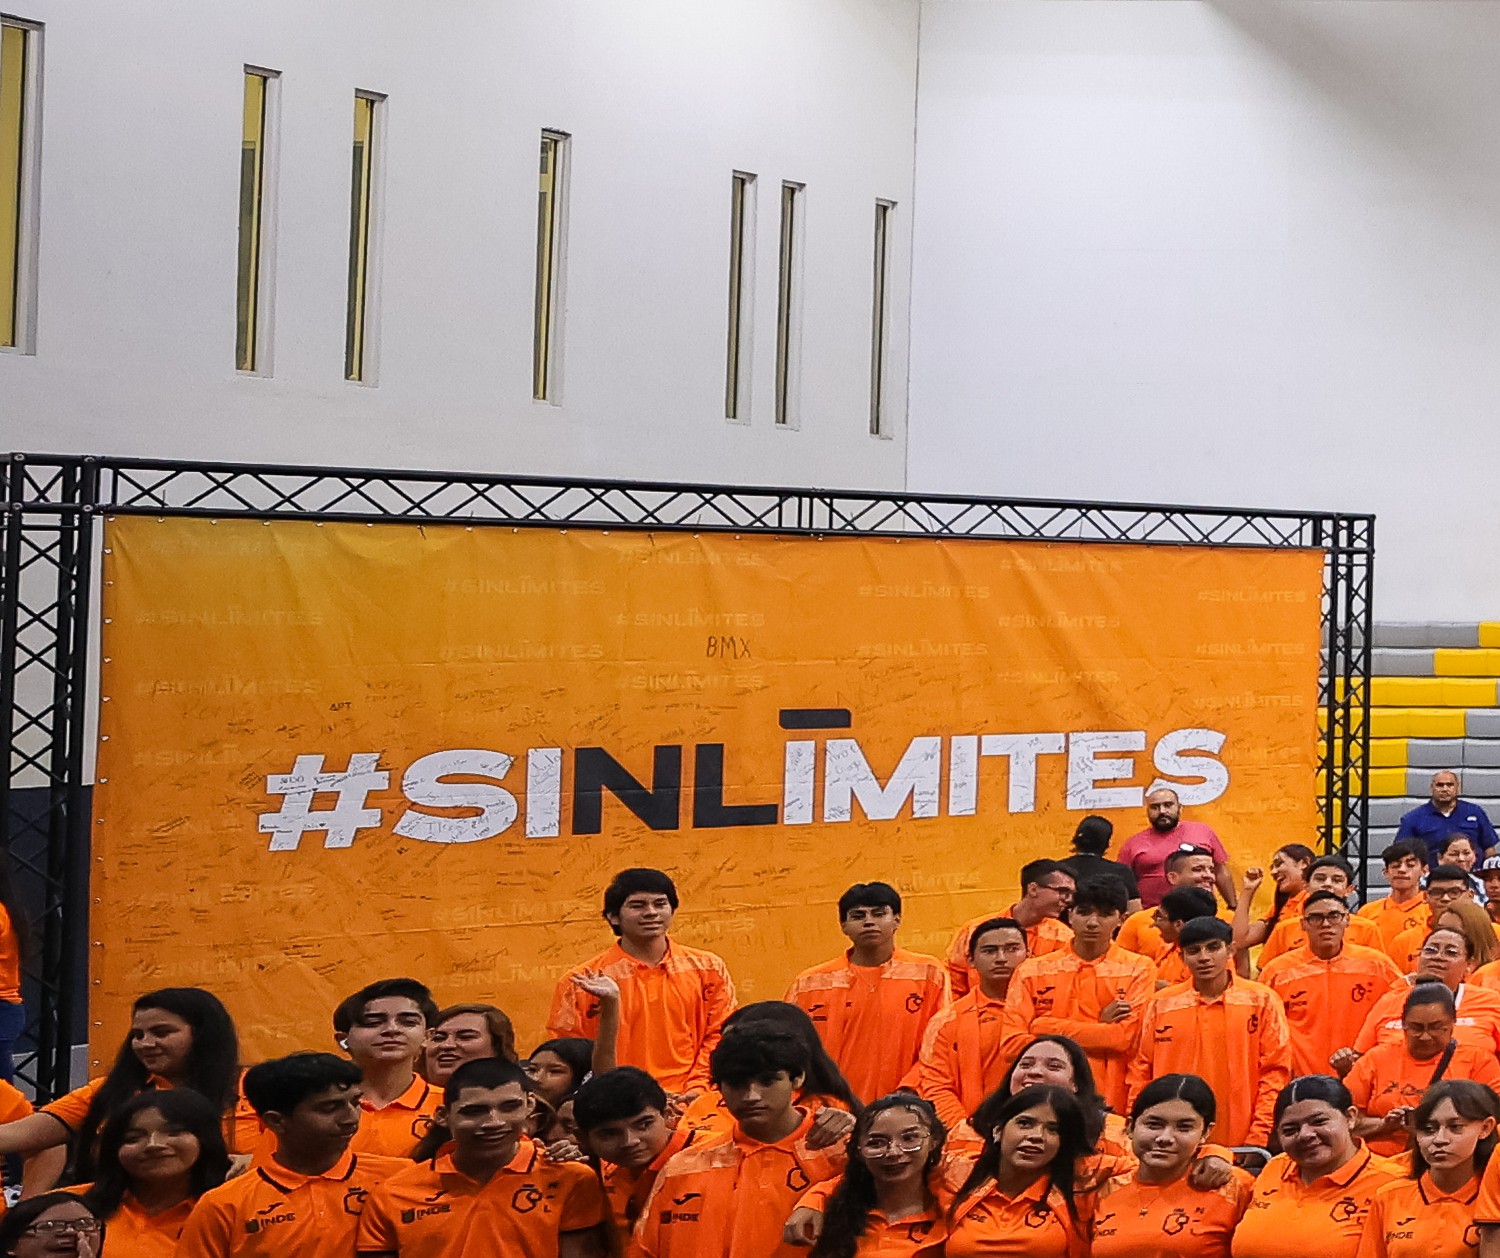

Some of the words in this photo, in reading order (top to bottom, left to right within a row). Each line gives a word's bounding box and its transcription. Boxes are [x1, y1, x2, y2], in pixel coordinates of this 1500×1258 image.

[706, 635, 751, 660] BMX
[261, 1212, 295, 1227] INDE
[417, 1204, 451, 1220] INDE
[672, 1213, 699, 1222] INDE
[966, 1214, 987, 1223] NDE
